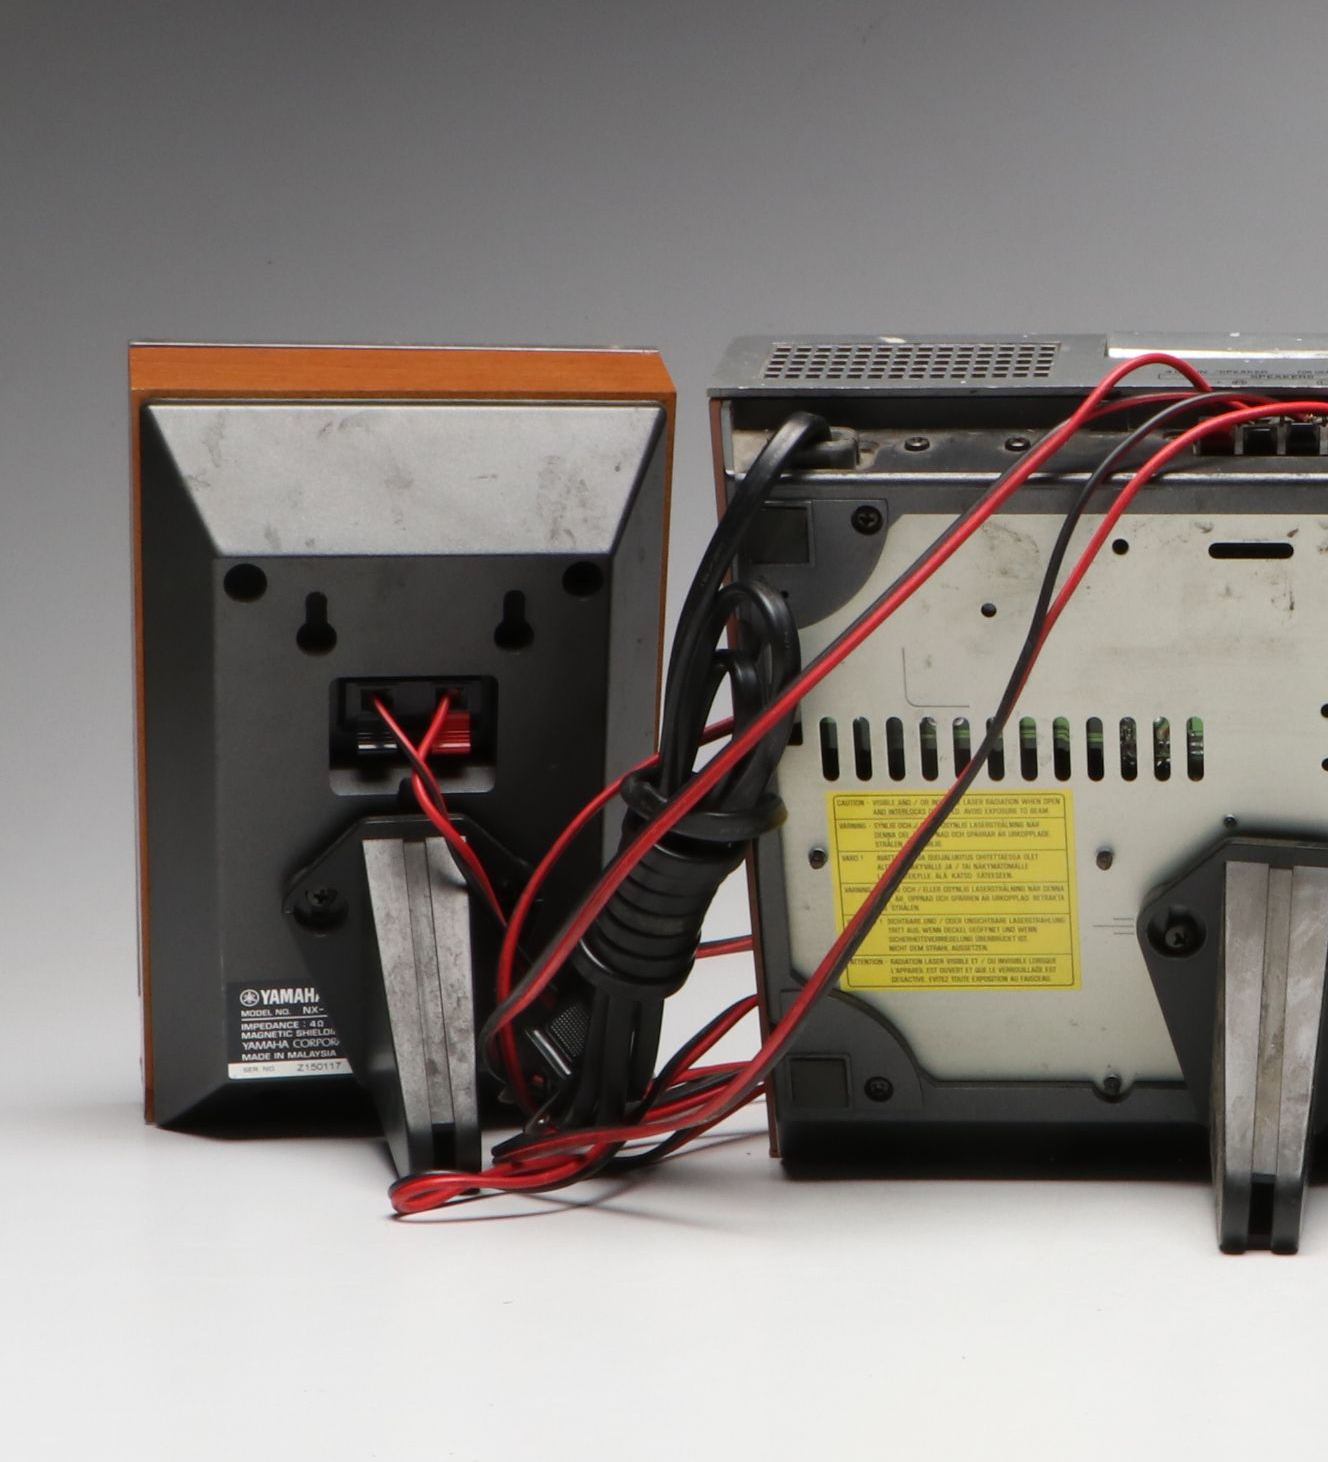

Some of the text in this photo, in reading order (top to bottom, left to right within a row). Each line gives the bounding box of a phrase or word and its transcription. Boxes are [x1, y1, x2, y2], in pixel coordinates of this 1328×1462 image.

[241, 1009, 272, 1017] MODEL
[241, 1021, 299, 1030] IMPEDANCE
[241, 1030, 293, 1039] MAGNETIC
[242, 1040, 289, 1050] YAMAHA
[242, 1050, 336, 1061] MADE IN MALAYSIA
[297, 1062, 341, 1072] Z150117
